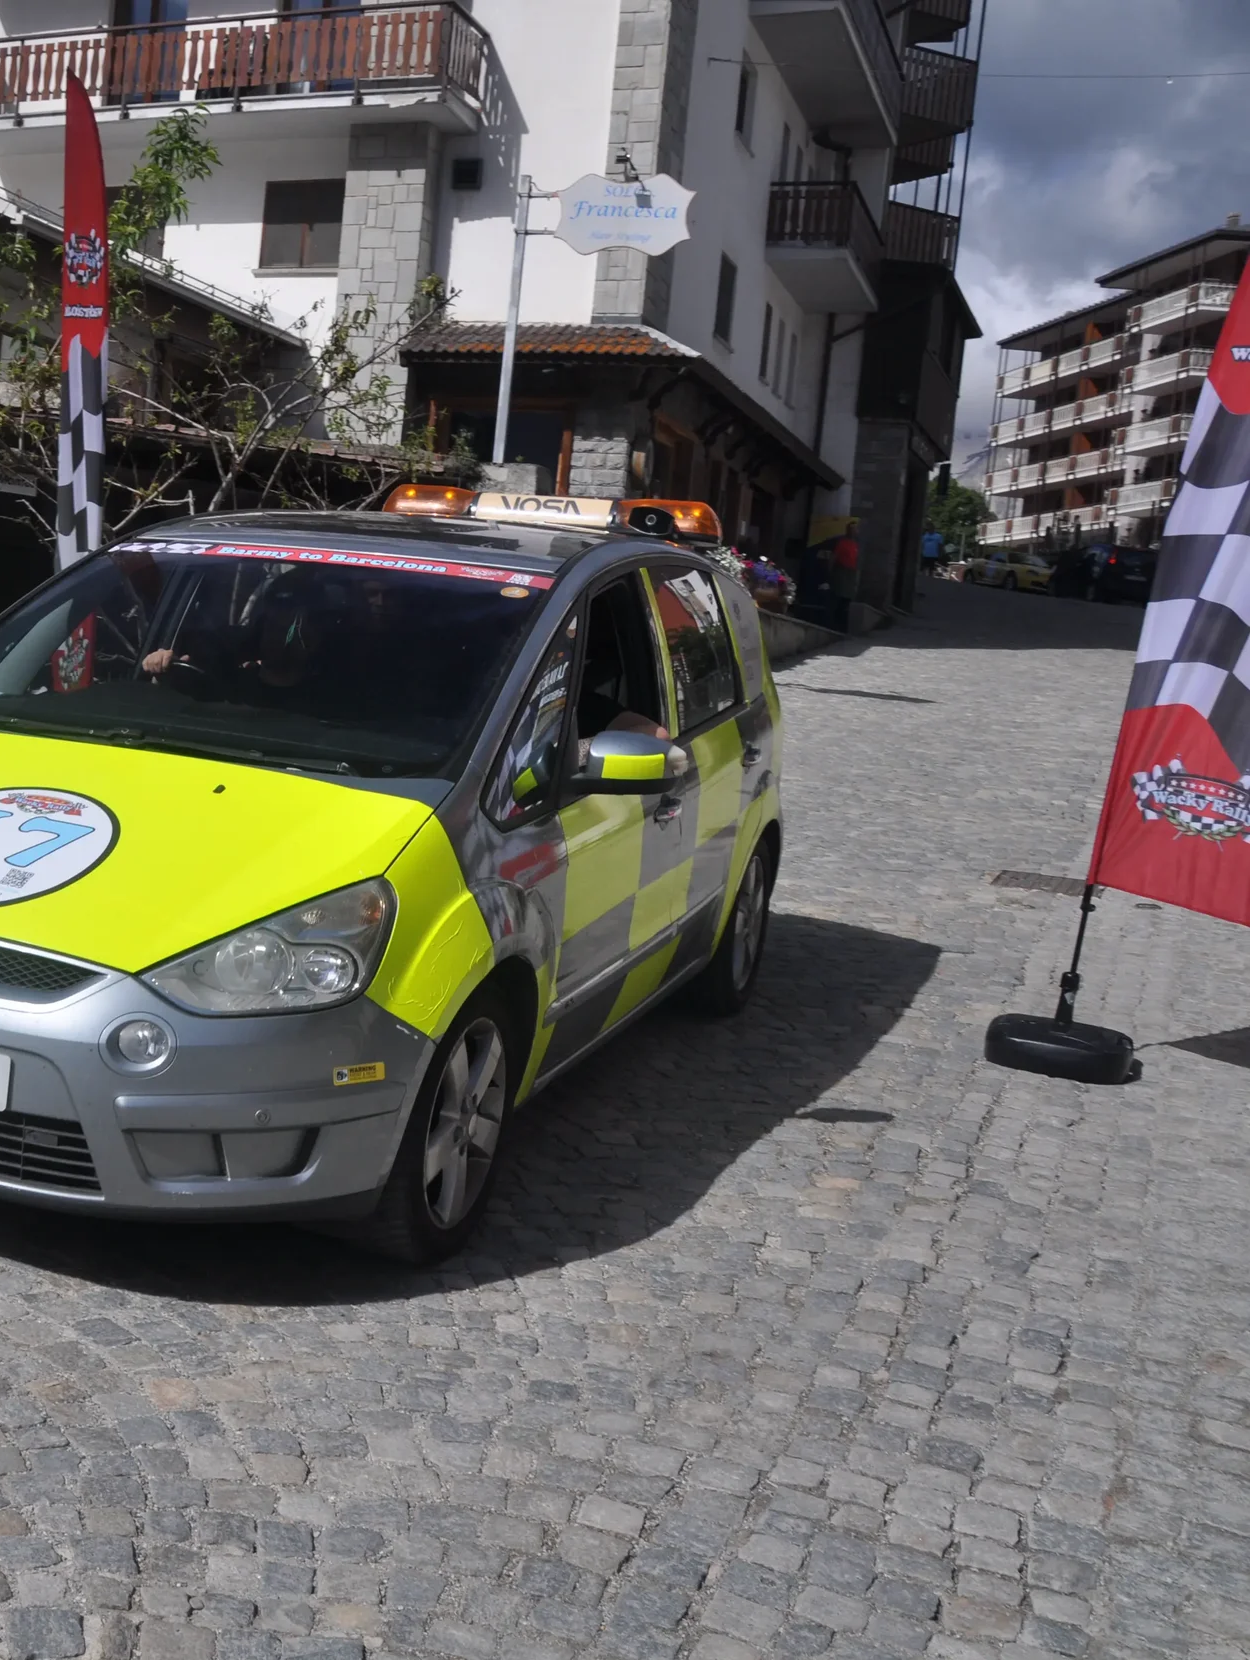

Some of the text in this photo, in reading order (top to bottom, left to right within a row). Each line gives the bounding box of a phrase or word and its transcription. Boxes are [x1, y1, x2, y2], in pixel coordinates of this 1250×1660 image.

[569, 200, 678, 220] Francesca
[501, 496, 581, 515] VOSA
[216, 546, 294, 560] Barmy
[298, 551, 325, 561] to
[327, 553, 448, 574] Barcelona
[1152, 790, 1209, 811] Wacky
